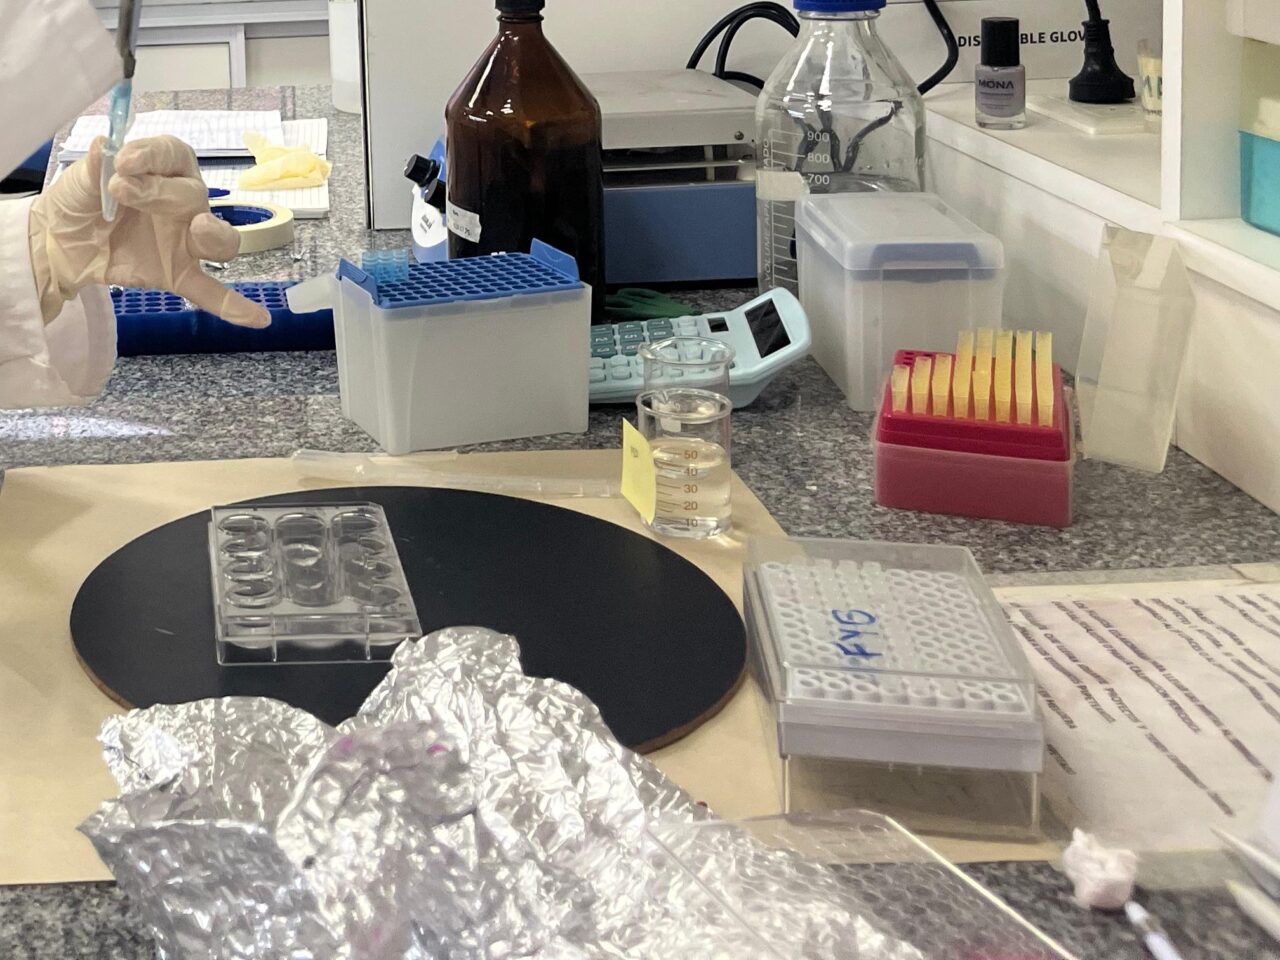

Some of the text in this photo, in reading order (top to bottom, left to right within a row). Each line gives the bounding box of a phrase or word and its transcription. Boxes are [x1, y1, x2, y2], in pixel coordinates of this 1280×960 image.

[1050, 30, 1085, 43] GLOV
[807, 130, 830, 141] 900
[807, 153, 830, 163] 800
[807, 173, 830, 184] 700
[684, 450, 698, 459] 50
[684, 467, 698, 476] 40
[684, 484, 698, 493] 30
[684, 501, 698, 510] 20
[686, 519, 698, 527] 10
